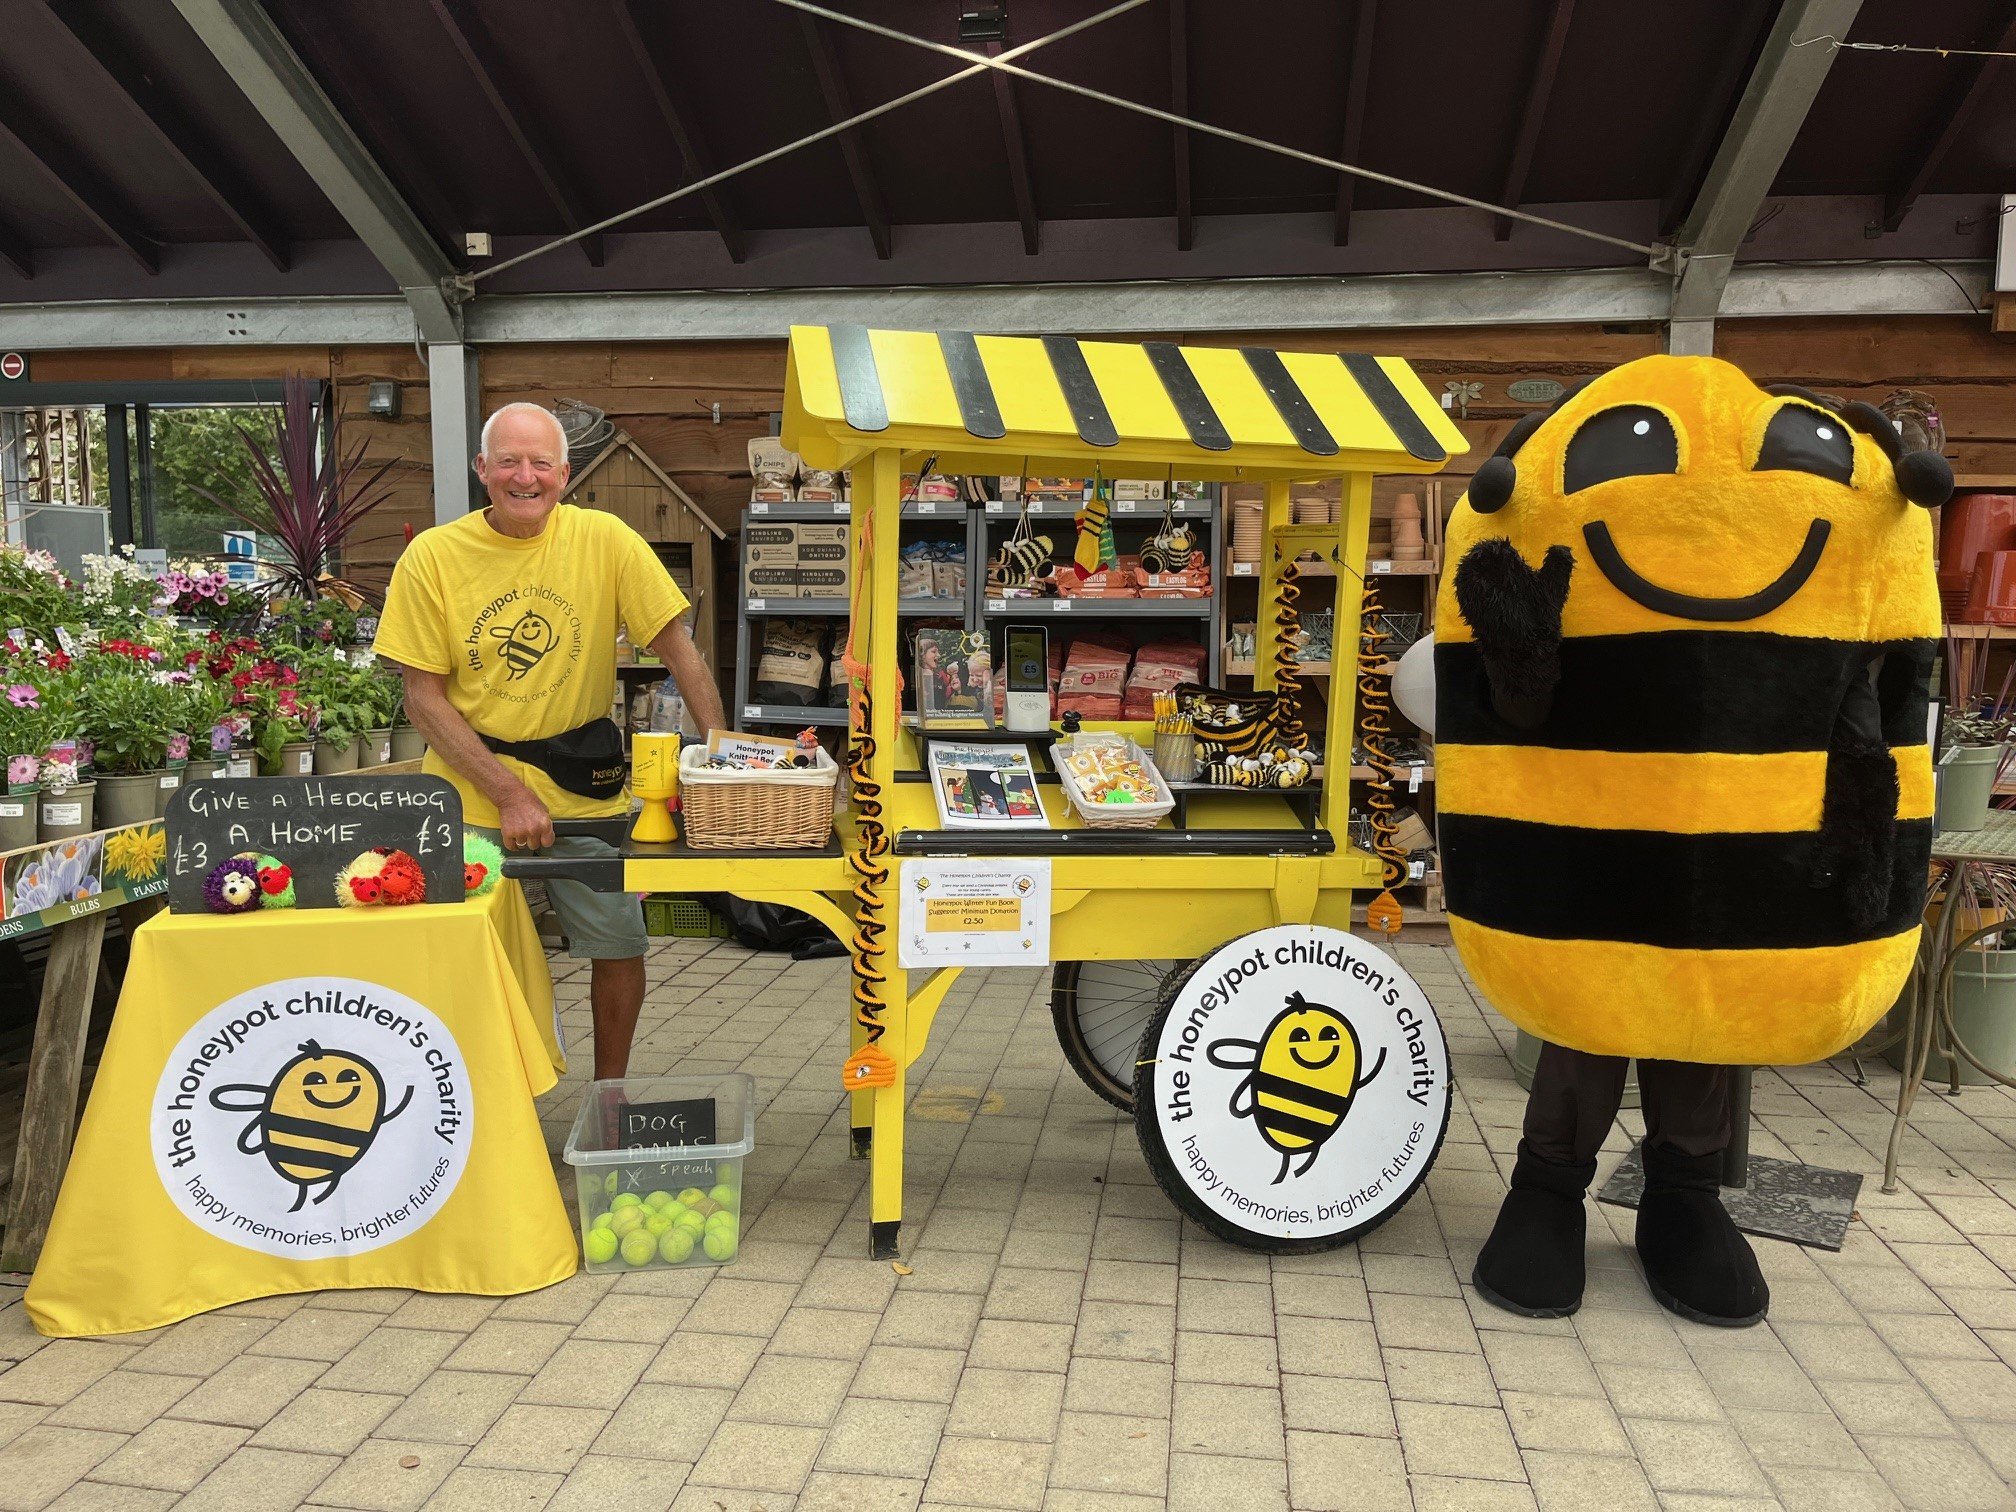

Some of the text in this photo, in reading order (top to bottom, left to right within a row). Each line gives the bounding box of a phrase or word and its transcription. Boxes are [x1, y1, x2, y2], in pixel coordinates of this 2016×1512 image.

[465, 584, 584, 671] the honeypot children's charity
[481, 668, 572, 703] one childhood, one chance
[1024, 665, 1037, 673] £5
[736, 744, 774, 755] Honeypot
[272, 794, 286, 807] A
[305, 783, 446, 812] HEDGEHOG
[229, 821, 361, 845] A HOME
[416, 816, 452, 856] £3
[174, 835, 208, 876] £3
[133, 881, 162, 897] PLANT
[70, 899, 100, 916] BULBS
[1168, 940, 1434, 1122] the honeypot children's charity
[167, 990, 462, 1168] the honeypot children's charity
[628, 1114, 686, 1134] DOG
[1182, 1122, 1424, 1224] happy memories, brighter futures
[185, 1156, 450, 1246] happy memories, brighter futures
